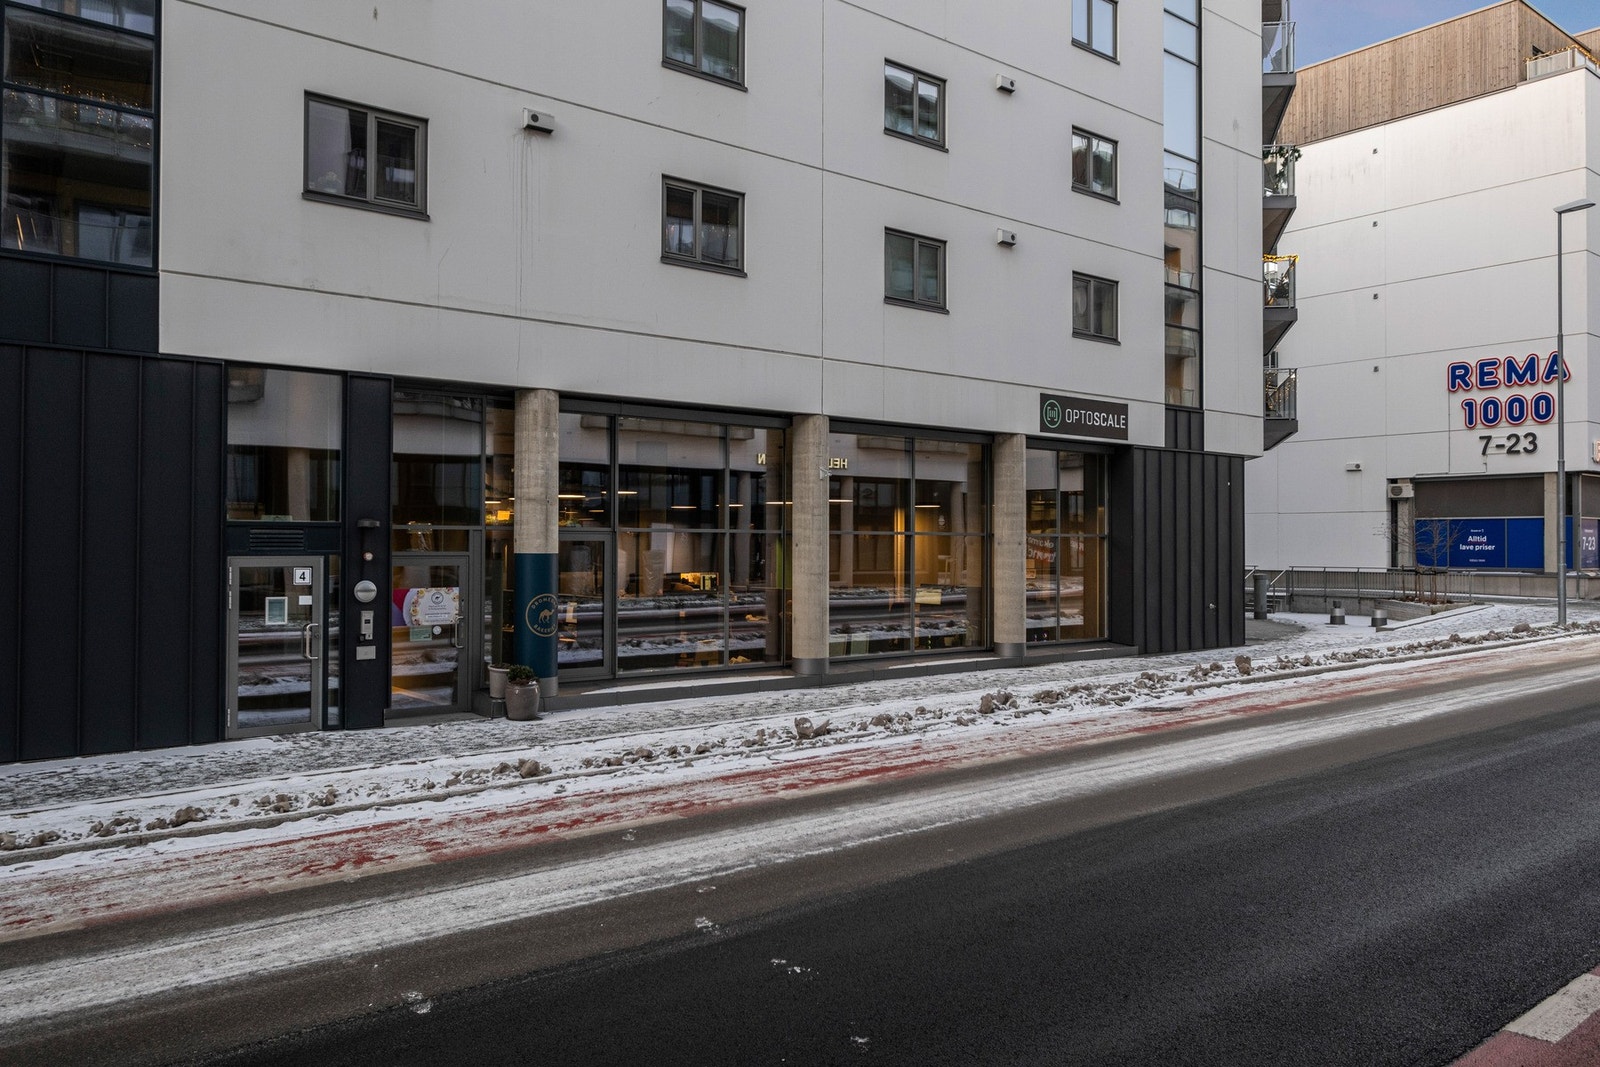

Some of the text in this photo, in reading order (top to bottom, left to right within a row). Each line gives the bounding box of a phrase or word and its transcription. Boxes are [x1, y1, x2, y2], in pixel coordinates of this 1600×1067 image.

[1448, 351, 1571, 392] REMA
[1065, 408, 1126, 429] OPTOSCALE
[1461, 392, 1555, 429] 1000
[1479, 432, 1538, 455] 7-23
[1459, 543, 1496, 551] lave priser
[1467, 535, 1487, 543] Alltid
[1582, 536, 1596, 550] 7-23
[299, 571, 307, 582] 4
